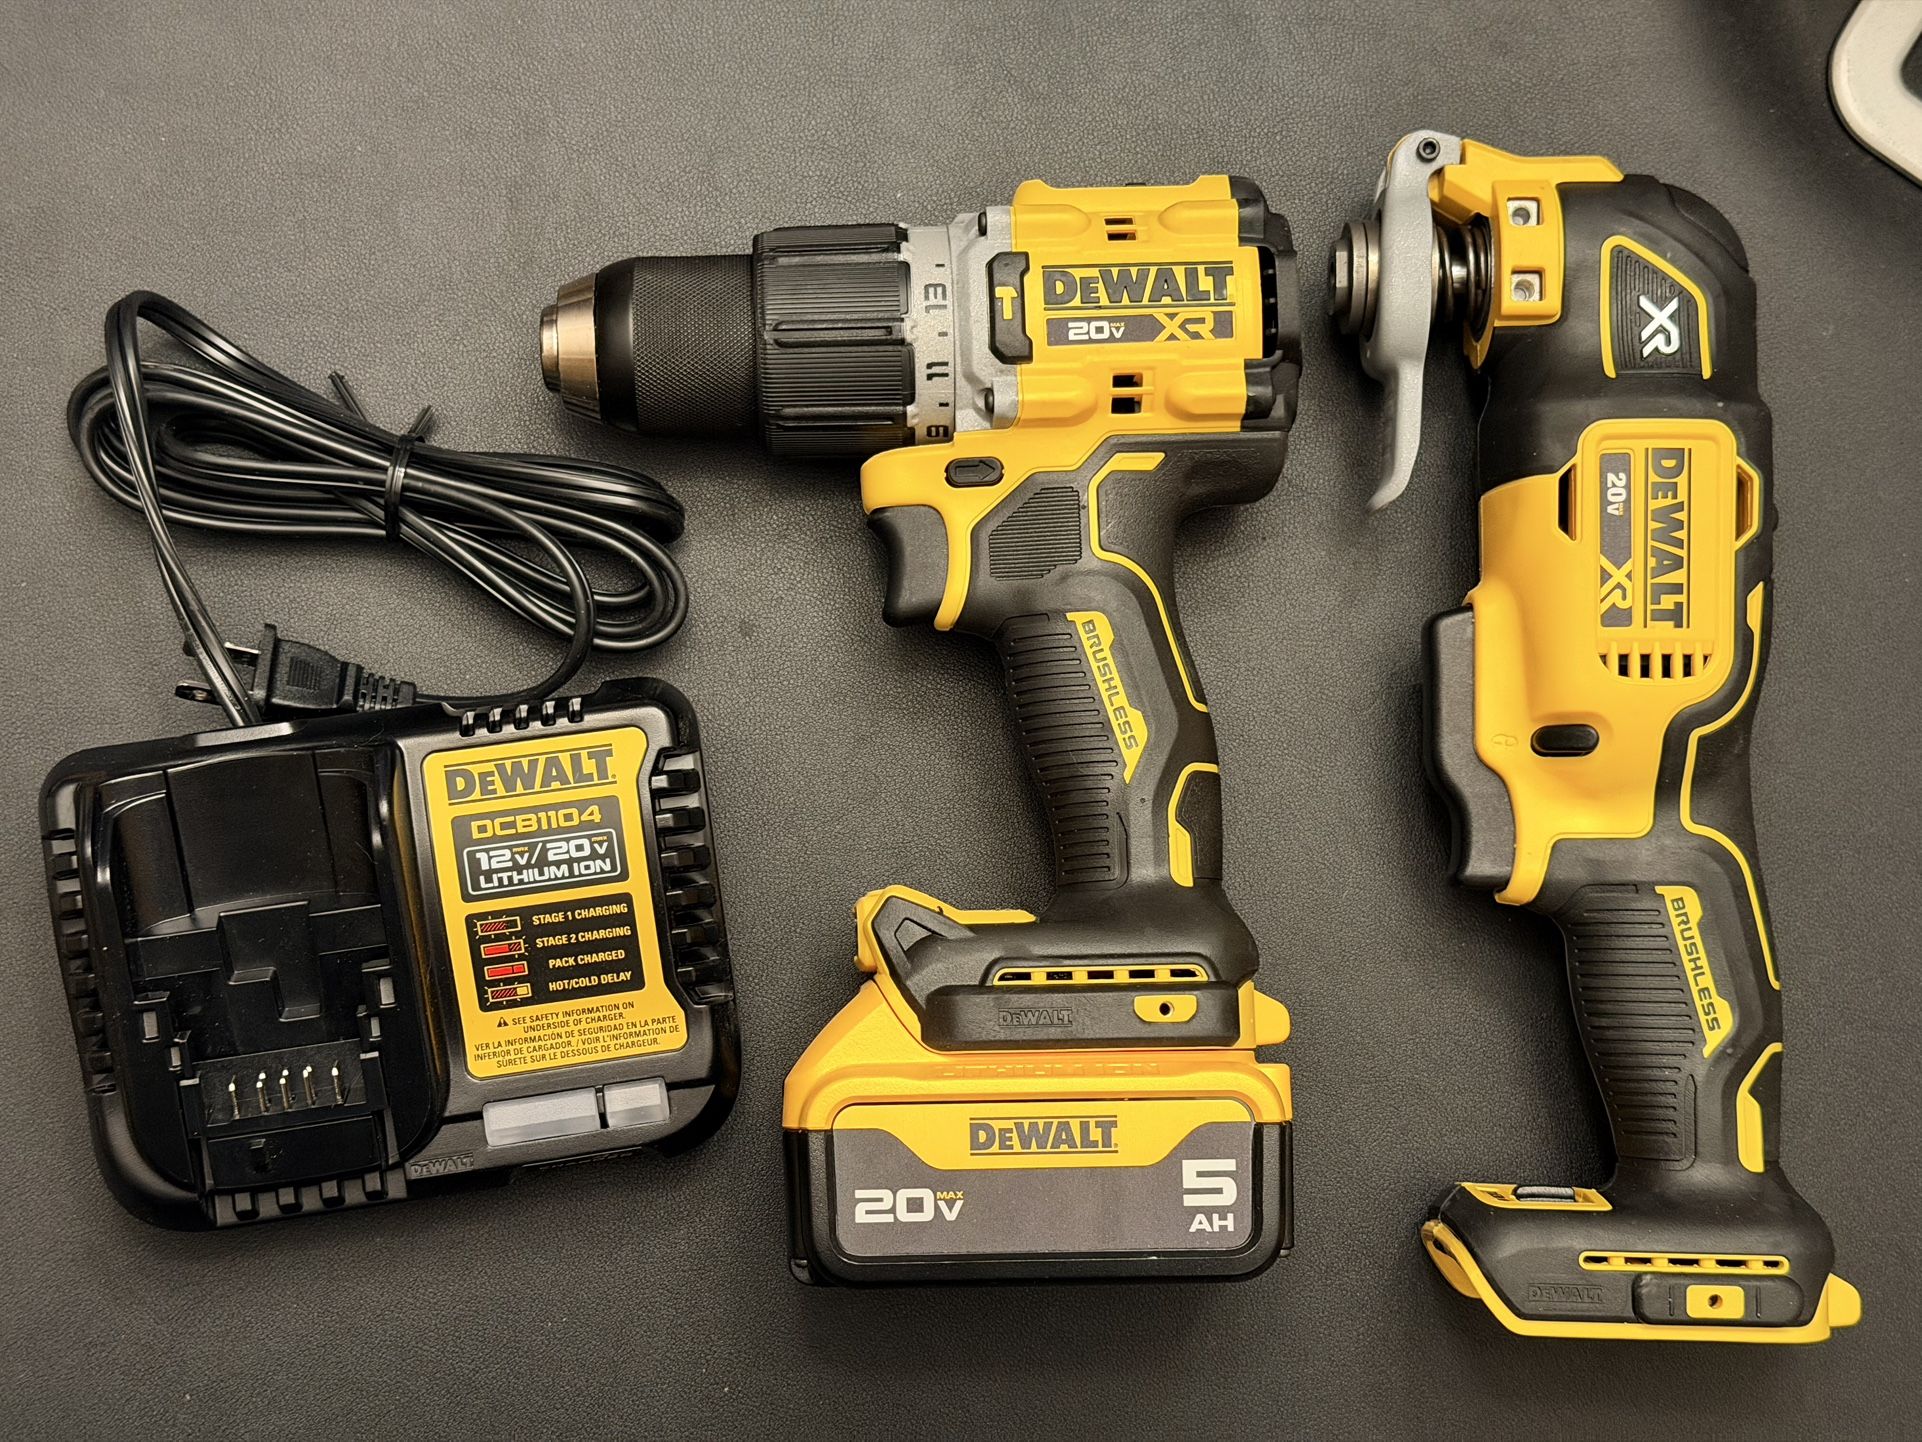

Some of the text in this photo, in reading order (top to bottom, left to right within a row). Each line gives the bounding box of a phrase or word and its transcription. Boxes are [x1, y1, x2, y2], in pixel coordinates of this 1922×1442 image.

[924, 283, 948, 314] 13
[1152, 312, 1216, 342] XR
[1639, 294, 1681, 359] XR
[926, 361, 949, 381] 11
[1600, 554, 1633, 614] XR
[1081, 619, 1138, 751] BRUSHLESS
[471, 805, 601, 839] DCB1104
[479, 858, 612, 889] LITHIUM ION
[532, 903, 628, 925] STAGE 1 CHARGING
[536, 926, 631, 948] STAGE 2 CHARGING
[548, 949, 625, 969] PACK CHARGED
[1671, 896, 1721, 1032] BRUSHLESS
[548, 971, 631, 991] HOT/COLD DELAY
[512, 1001, 635, 1025] SEE SAFETY INFORMATION ON
[523, 1012, 626, 1033] UNDERSIDE OF CHARGER.
[474, 1043, 490, 1052] VER
[492, 1041, 503, 1049] LA
[565, 1030, 575, 1038] DE
[577, 1023, 624, 1037] SEGURIDAD
[626, 1021, 637, 1030] EN
[640, 1019, 649, 1028] LA
[651, 1015, 677, 1026] PARTE
[474, 1049, 511, 1062] INFERIOR
[513, 1047, 524, 1056] DE
[526, 1040, 574, 1054] CARGADOR.
[581, 1036, 601, 1046] VOIR
[603, 1026, 667, 1043] L'INFORMATION
[669, 1024, 680, 1034] DE
[530, 1054, 547, 1064] SUR
[549, 1052, 558, 1060] LE
[560, 1046, 598, 1059] DESSOUS
[601, 1043, 612, 1053] DE
[613, 1037, 661, 1051] CHARGEUR.
[936, 1191, 964, 1199] MAX
[1182, 1158, 1237, 1207] 5
[1189, 1213, 1235, 1232] AH
